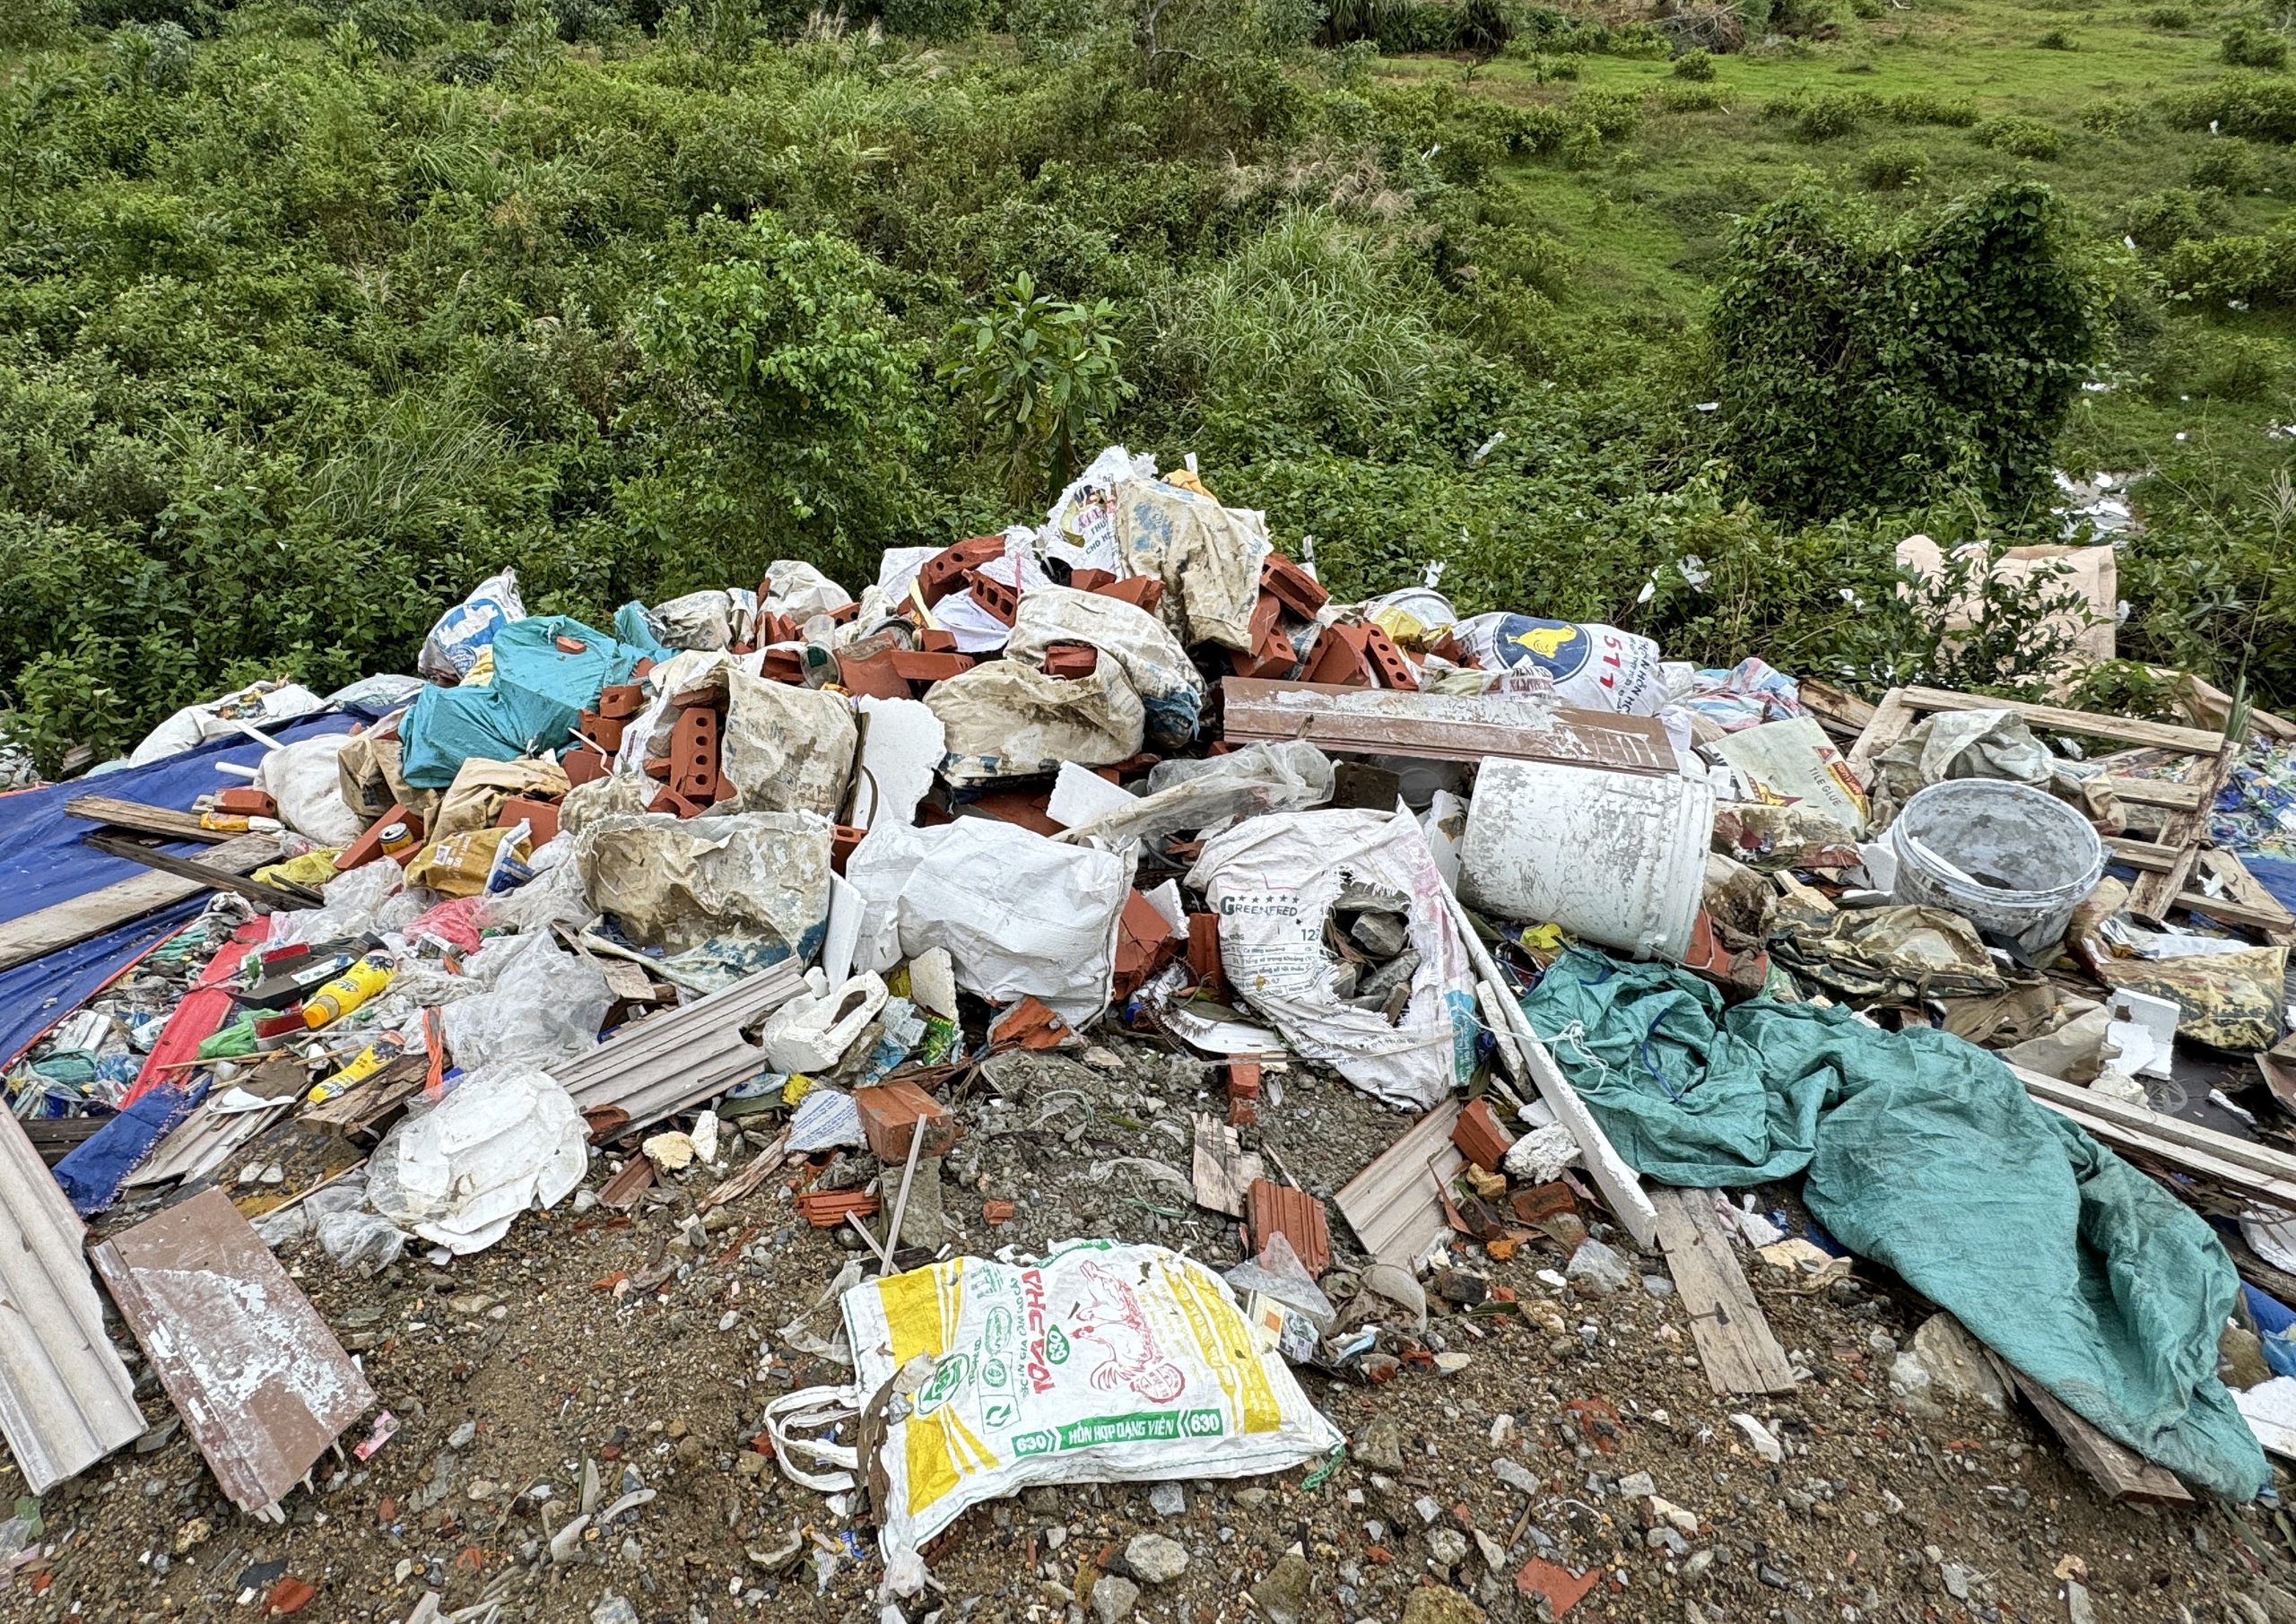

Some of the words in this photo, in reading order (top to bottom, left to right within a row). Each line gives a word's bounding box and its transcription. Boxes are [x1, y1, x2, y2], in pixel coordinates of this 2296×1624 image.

[1085, 540, 1100, 554] CHO
[1600, 635, 1622, 690] 511
[1809, 767, 1826, 786] TILE
[1822, 785, 1841, 807] GLUE
[1220, 896, 1298, 916] GREENFEED
[1020, 1340, 1028, 1359] GIA
[1048, 1330, 1065, 1361] 630
[1015, 1436, 1047, 1452] 630
[1094, 1423, 1116, 1442] HỢP
[1116, 1420, 1145, 1440] DẠNG
[1148, 1415, 1175, 1436] VIÊN
[1190, 1413, 1221, 1432] 630
